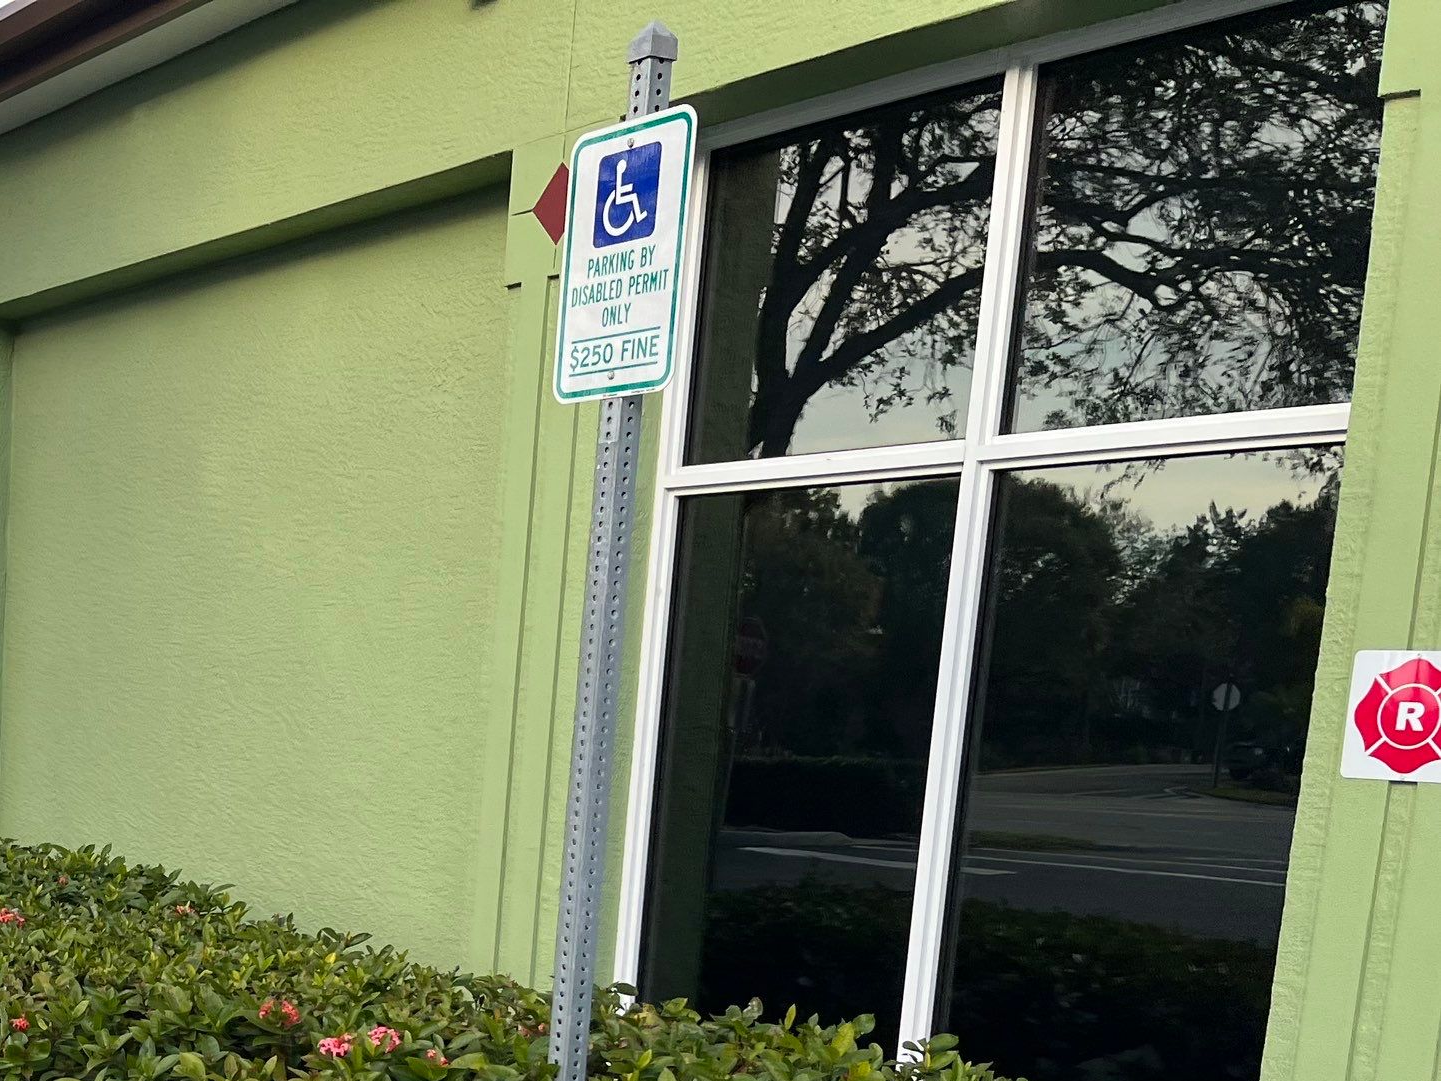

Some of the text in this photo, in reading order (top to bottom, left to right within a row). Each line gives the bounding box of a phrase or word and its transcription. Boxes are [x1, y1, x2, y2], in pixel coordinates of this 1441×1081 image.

[587, 244, 656, 279] PARKING BY
[571, 268, 669, 308] DISABLED PERMIT
[601, 302, 632, 328] ONLY
[569, 335, 660, 371] $250 FINE
[1395, 701, 1426, 732] R
